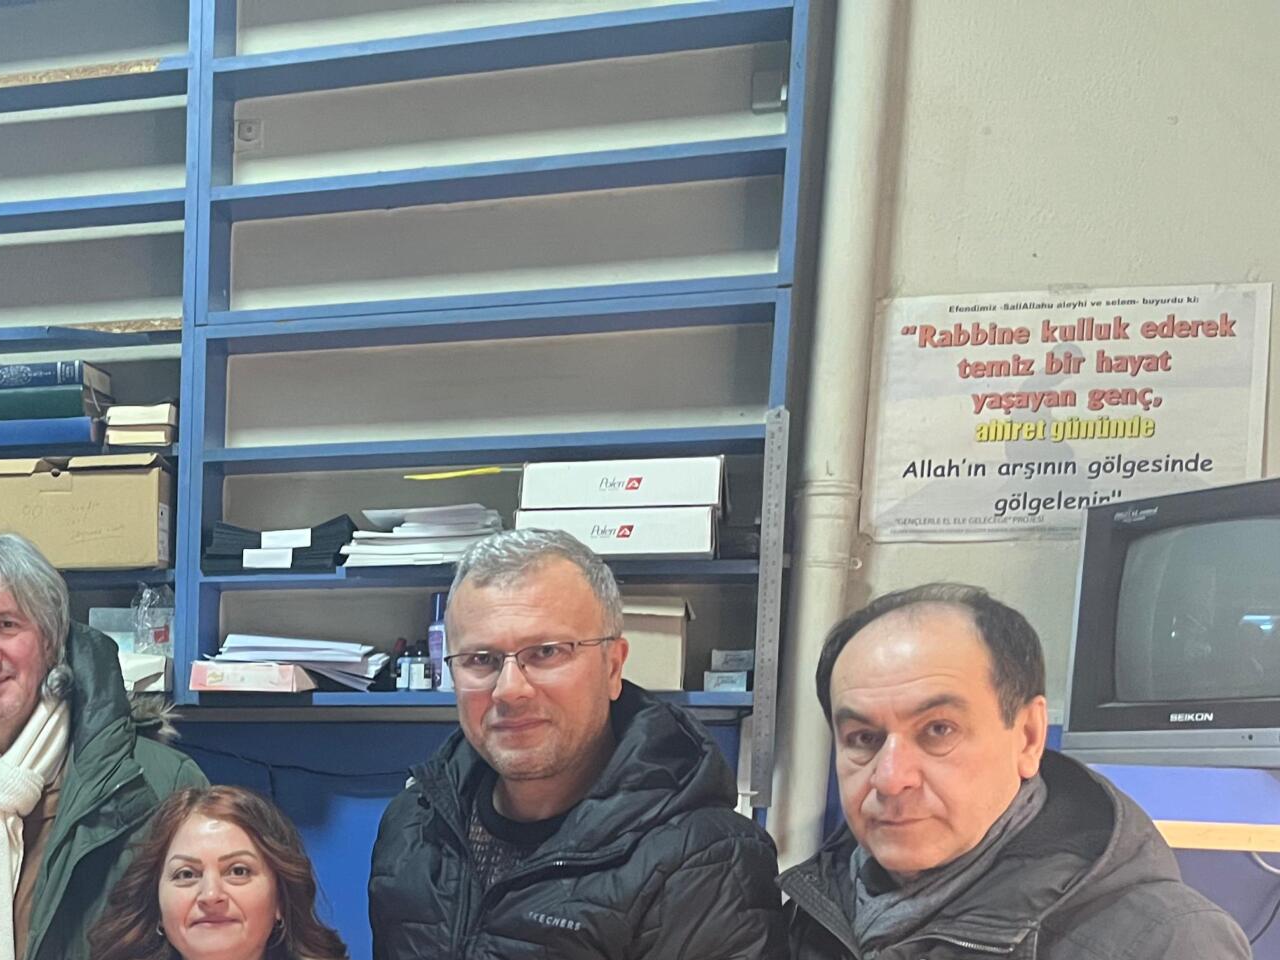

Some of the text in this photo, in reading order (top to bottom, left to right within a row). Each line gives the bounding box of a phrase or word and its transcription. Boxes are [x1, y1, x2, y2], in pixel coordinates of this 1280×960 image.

[948, 303, 997, 313] Efendimiz
[1142, 297, 1184, 306] buyurdu
[1041, 315, 1130, 343] kulluk
[1140, 312, 1237, 339] ederek
[957, 349, 1172, 379] temiz bir hayat
[971, 387, 1163, 415] yaşayan genç,
[975, 415, 1156, 443] ahiret gününde
[997, 460, 1077, 480] arşının
[1087, 452, 1214, 480] gölgesinde
